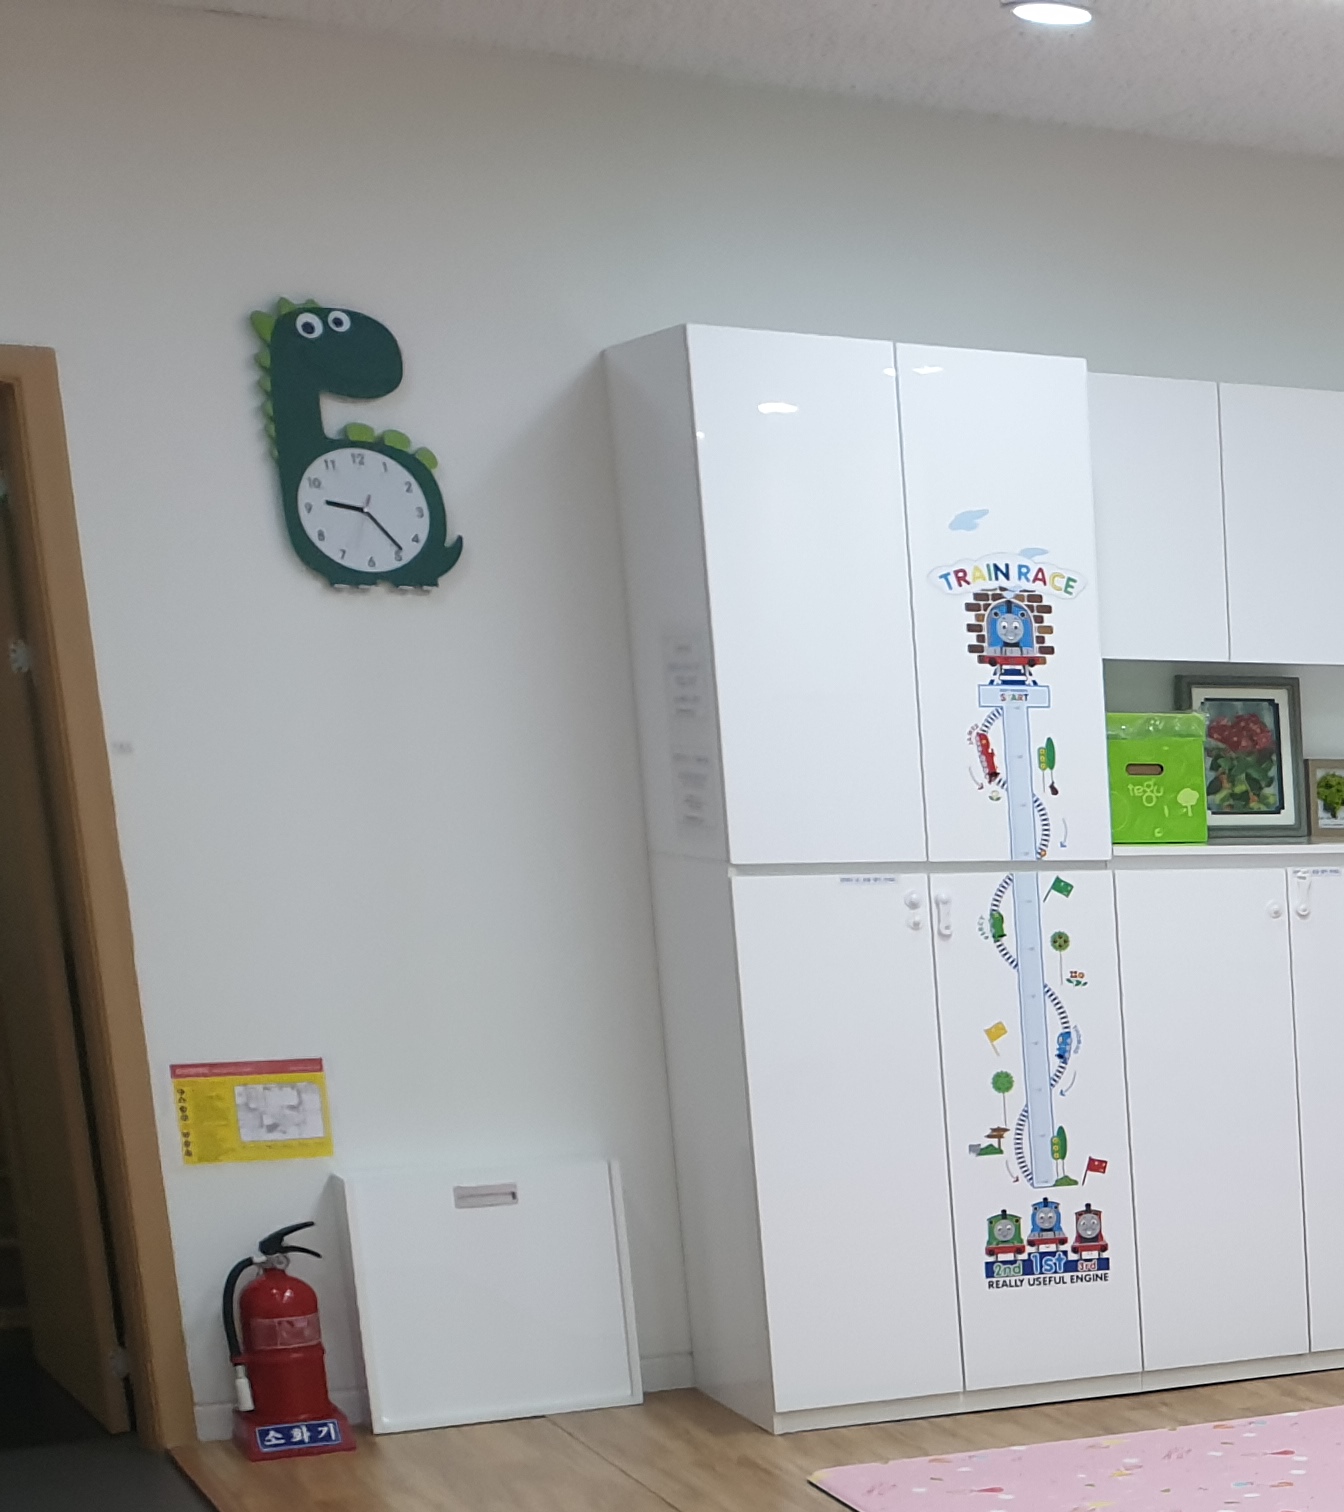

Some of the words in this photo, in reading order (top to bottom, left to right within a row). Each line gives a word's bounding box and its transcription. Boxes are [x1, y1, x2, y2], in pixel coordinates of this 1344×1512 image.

[351, 453, 365, 466] 12
[938, 562, 1010, 591] TRAIN
[1017, 563, 1078, 596] RACE
[1000, 693, 1029, 701] START
[994, 1261, 1022, 1277] 2nd
[1031, 1252, 1066, 1274] 1st
[1078, 1260, 1098, 1271] 3rd
[988, 1278, 1025, 1289] REALLY
[1028, 1275, 1067, 1287] USEFUL
[1070, 1273, 1109, 1284] ENGINE
[264, 1423, 336, 1446] 소화기
